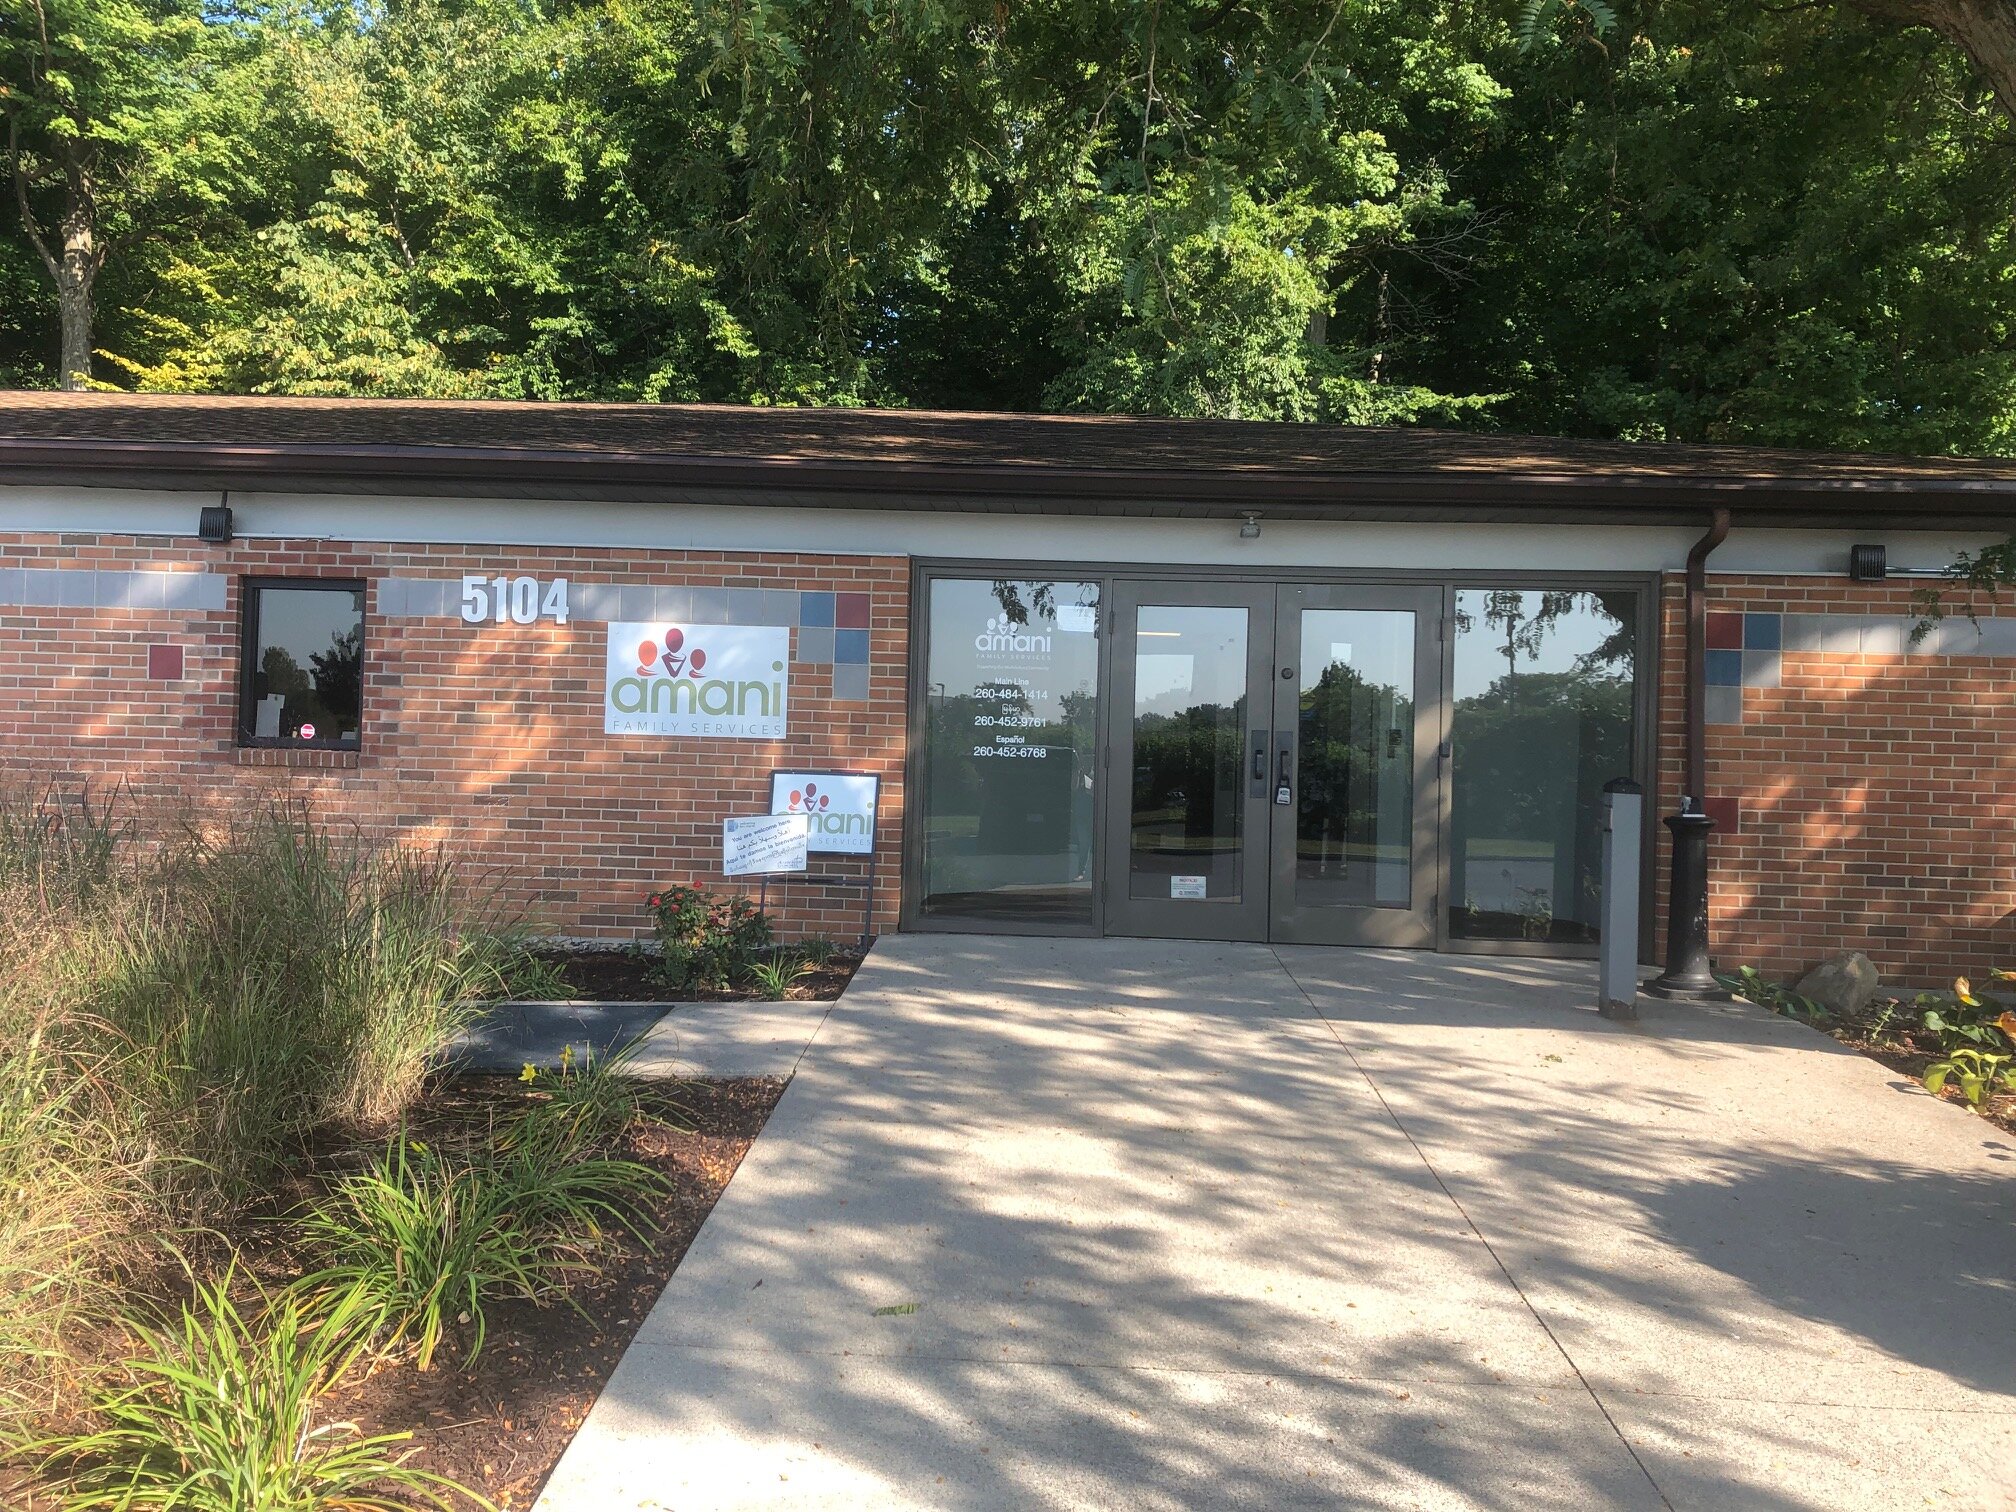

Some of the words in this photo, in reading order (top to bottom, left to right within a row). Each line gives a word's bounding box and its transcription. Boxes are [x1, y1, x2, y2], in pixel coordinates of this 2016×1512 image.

[461, 575, 570, 624] 5104
[975, 626, 1052, 652] amani
[994, 677, 1013, 685] Main
[1013, 677, 1030, 686] Line
[610, 660, 784, 717] amani
[975, 688, 1048, 700] 260-484-1414
[613, 720, 679, 732] FAMILY
[691, 722, 782, 735] SERVICES
[974, 715, 1046, 728] 260-452-9761
[995, 735, 1025, 745] Español
[973, 745, 1047, 758] 260-452-6768
[754, 824, 778, 835] welcome
[819, 836, 872, 846] SERVICES
